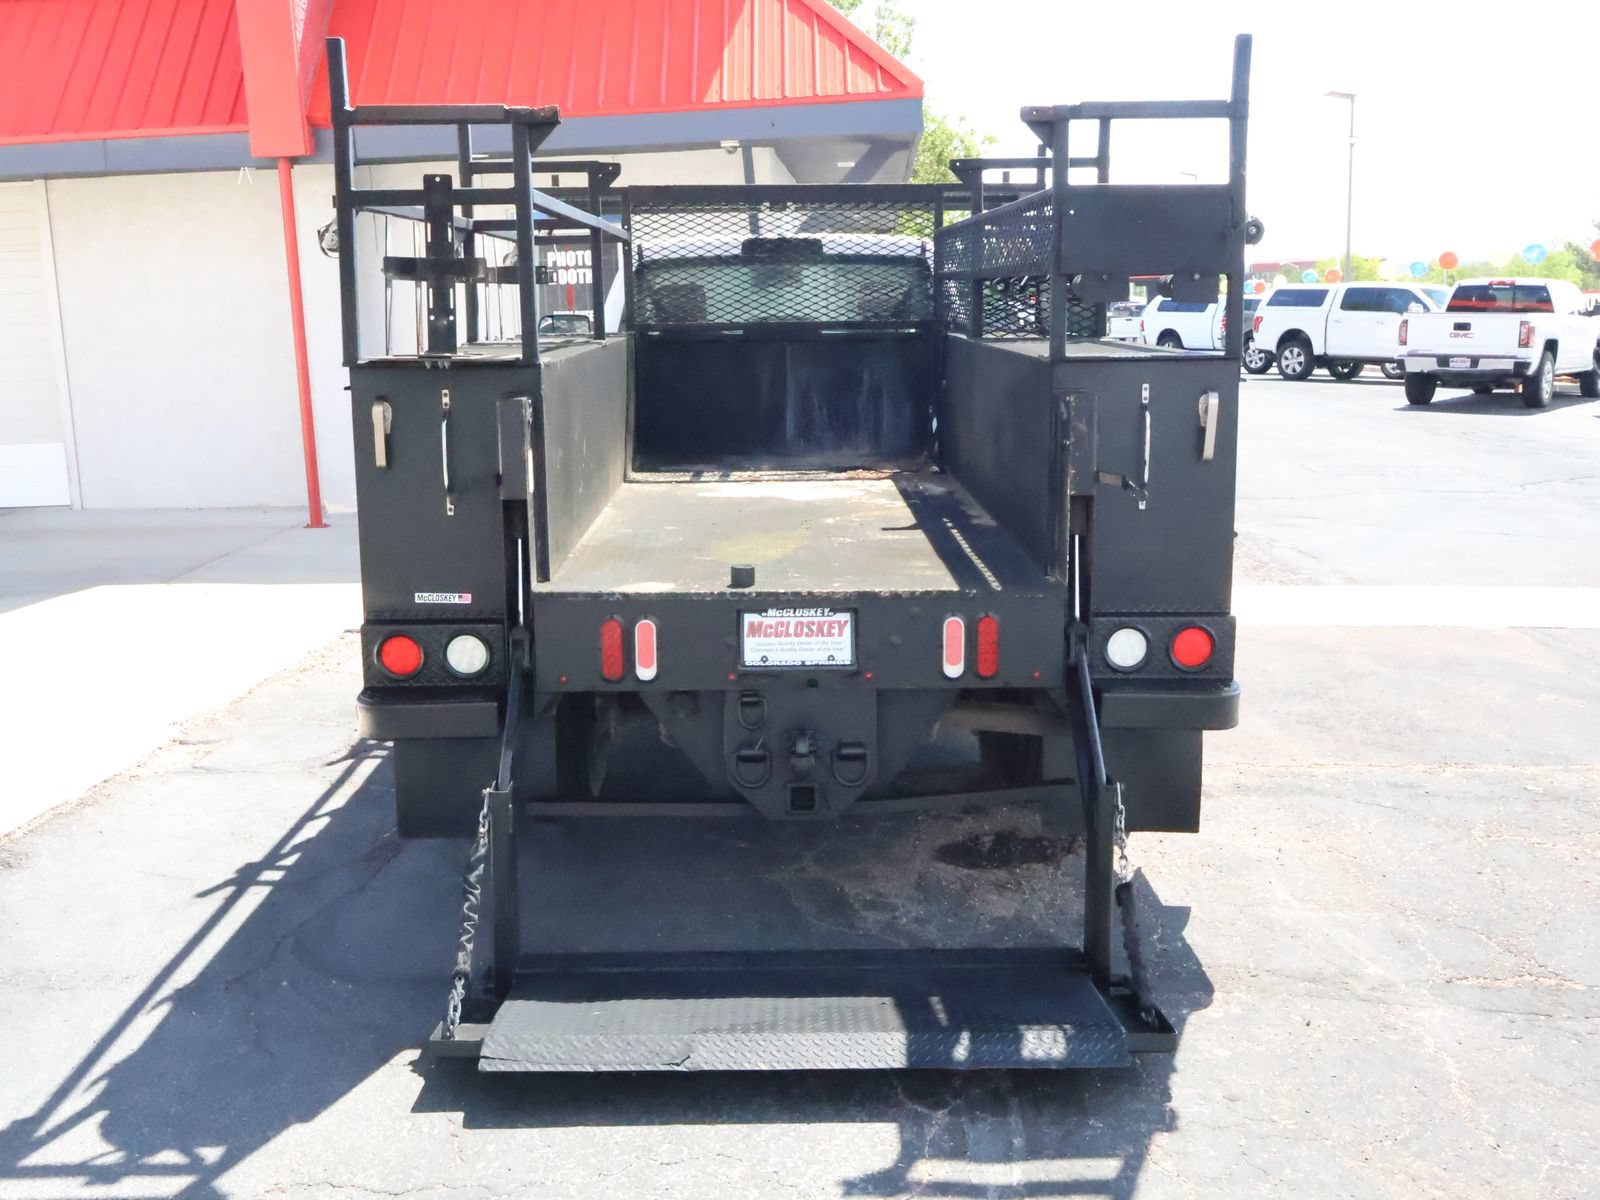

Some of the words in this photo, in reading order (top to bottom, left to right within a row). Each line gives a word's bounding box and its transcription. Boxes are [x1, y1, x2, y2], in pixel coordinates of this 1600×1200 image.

[547, 250, 592, 267] PHOTO
[416, 594, 457, 602] McCLOSKEY
[767, 608, 830, 617] McCLOSKEY
[746, 620, 848, 638] McCLOSKEY
